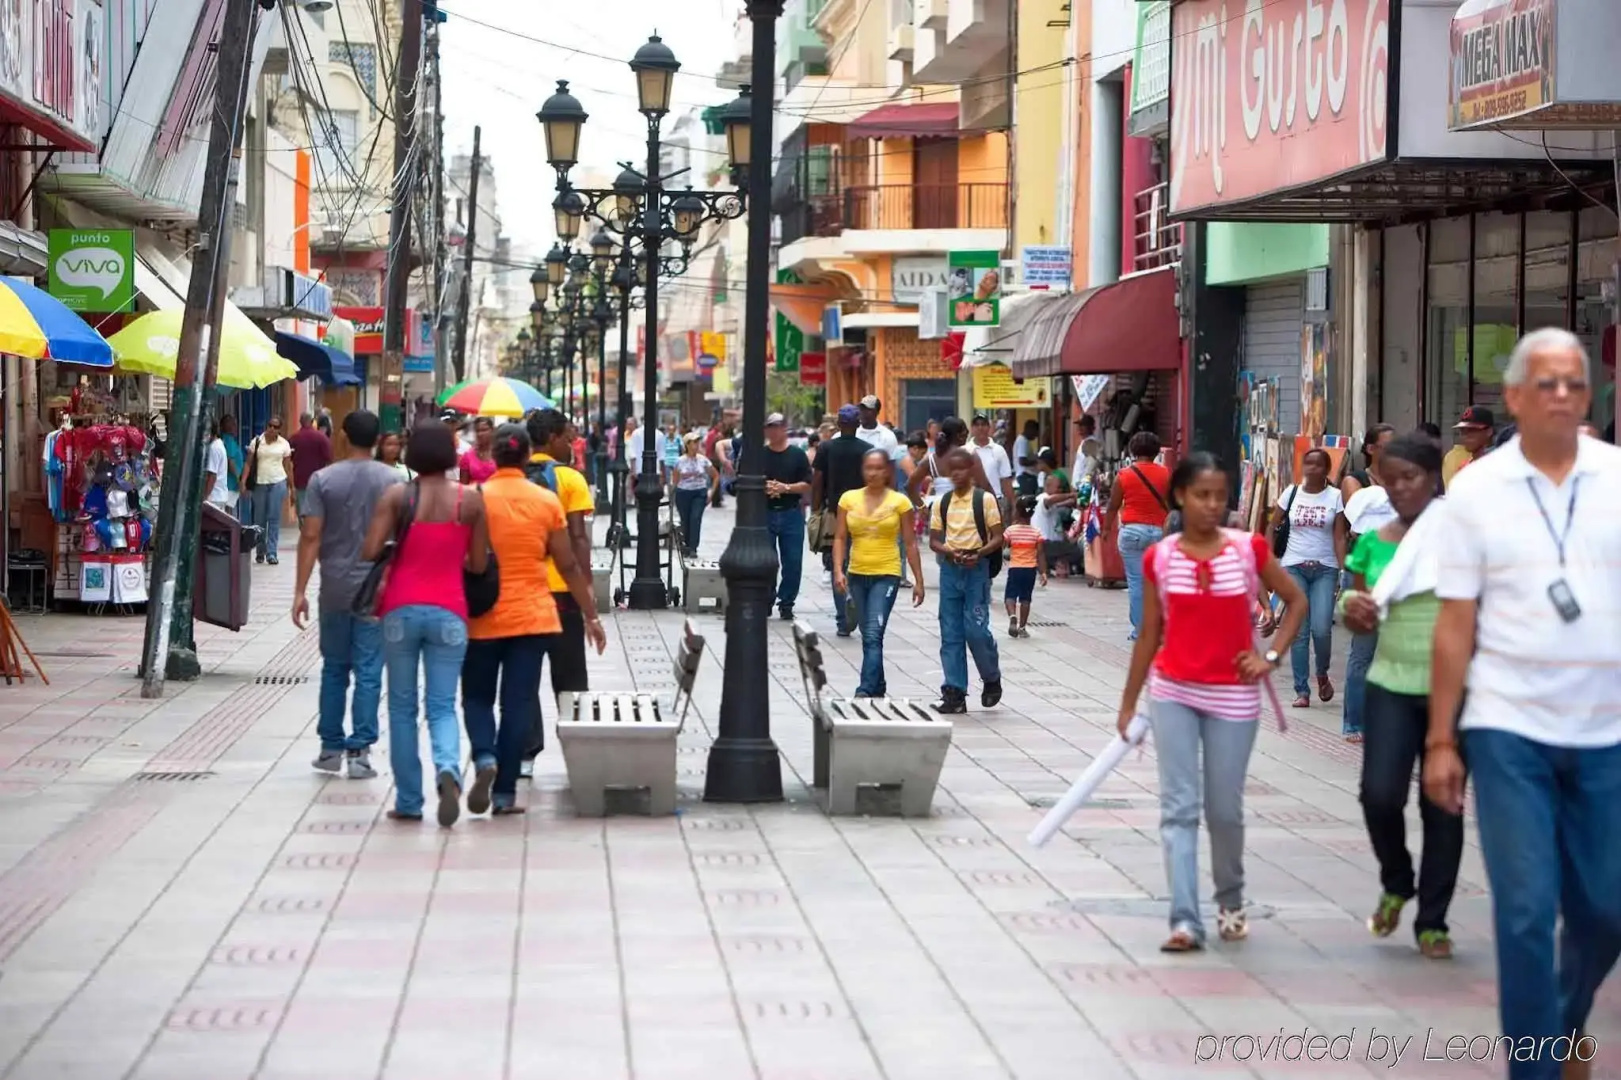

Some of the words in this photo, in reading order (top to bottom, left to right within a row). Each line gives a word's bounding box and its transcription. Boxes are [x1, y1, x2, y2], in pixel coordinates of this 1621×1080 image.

[1240, 0, 1348, 142] Gusto
[1460, 21, 1502, 89] MEGA
[1503, 7, 1542, 77] MAX
[71, 232, 110, 246] punto
[62, 258, 120, 274] viva
